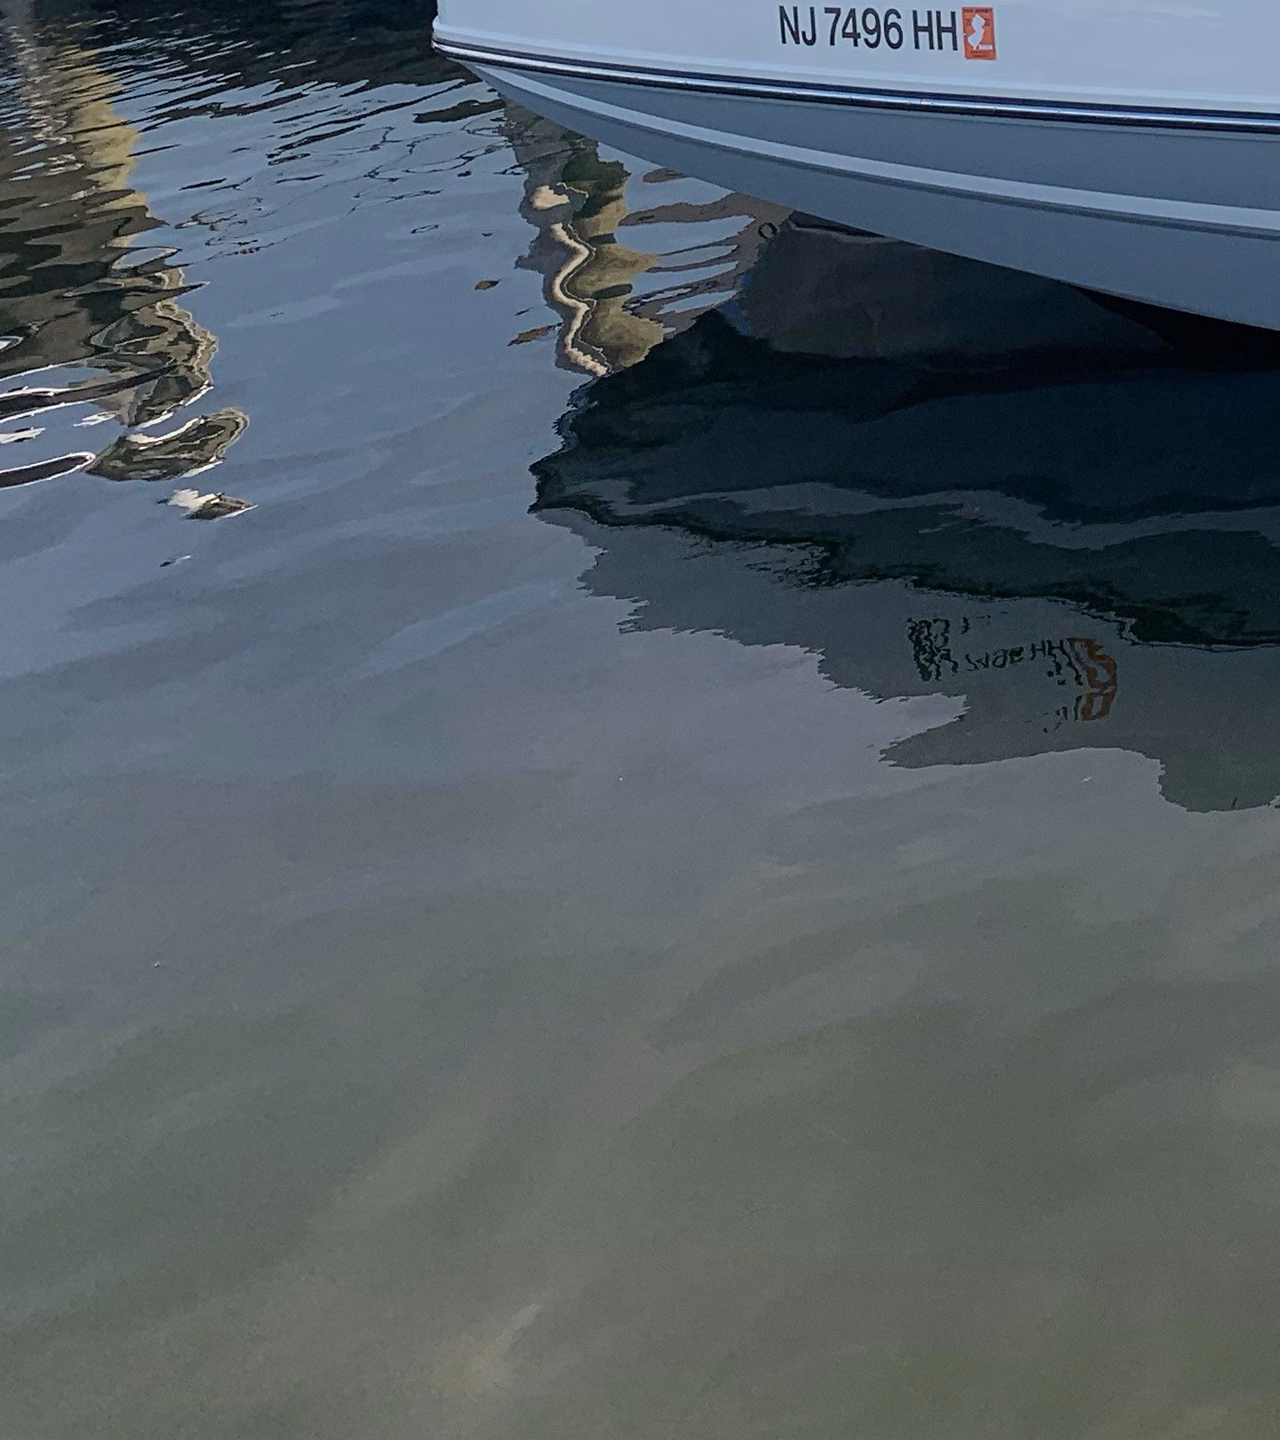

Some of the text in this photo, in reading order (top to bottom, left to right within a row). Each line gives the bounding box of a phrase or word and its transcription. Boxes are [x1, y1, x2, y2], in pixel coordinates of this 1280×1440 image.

[777, 5, 959, 51] NJ 7496 HH
